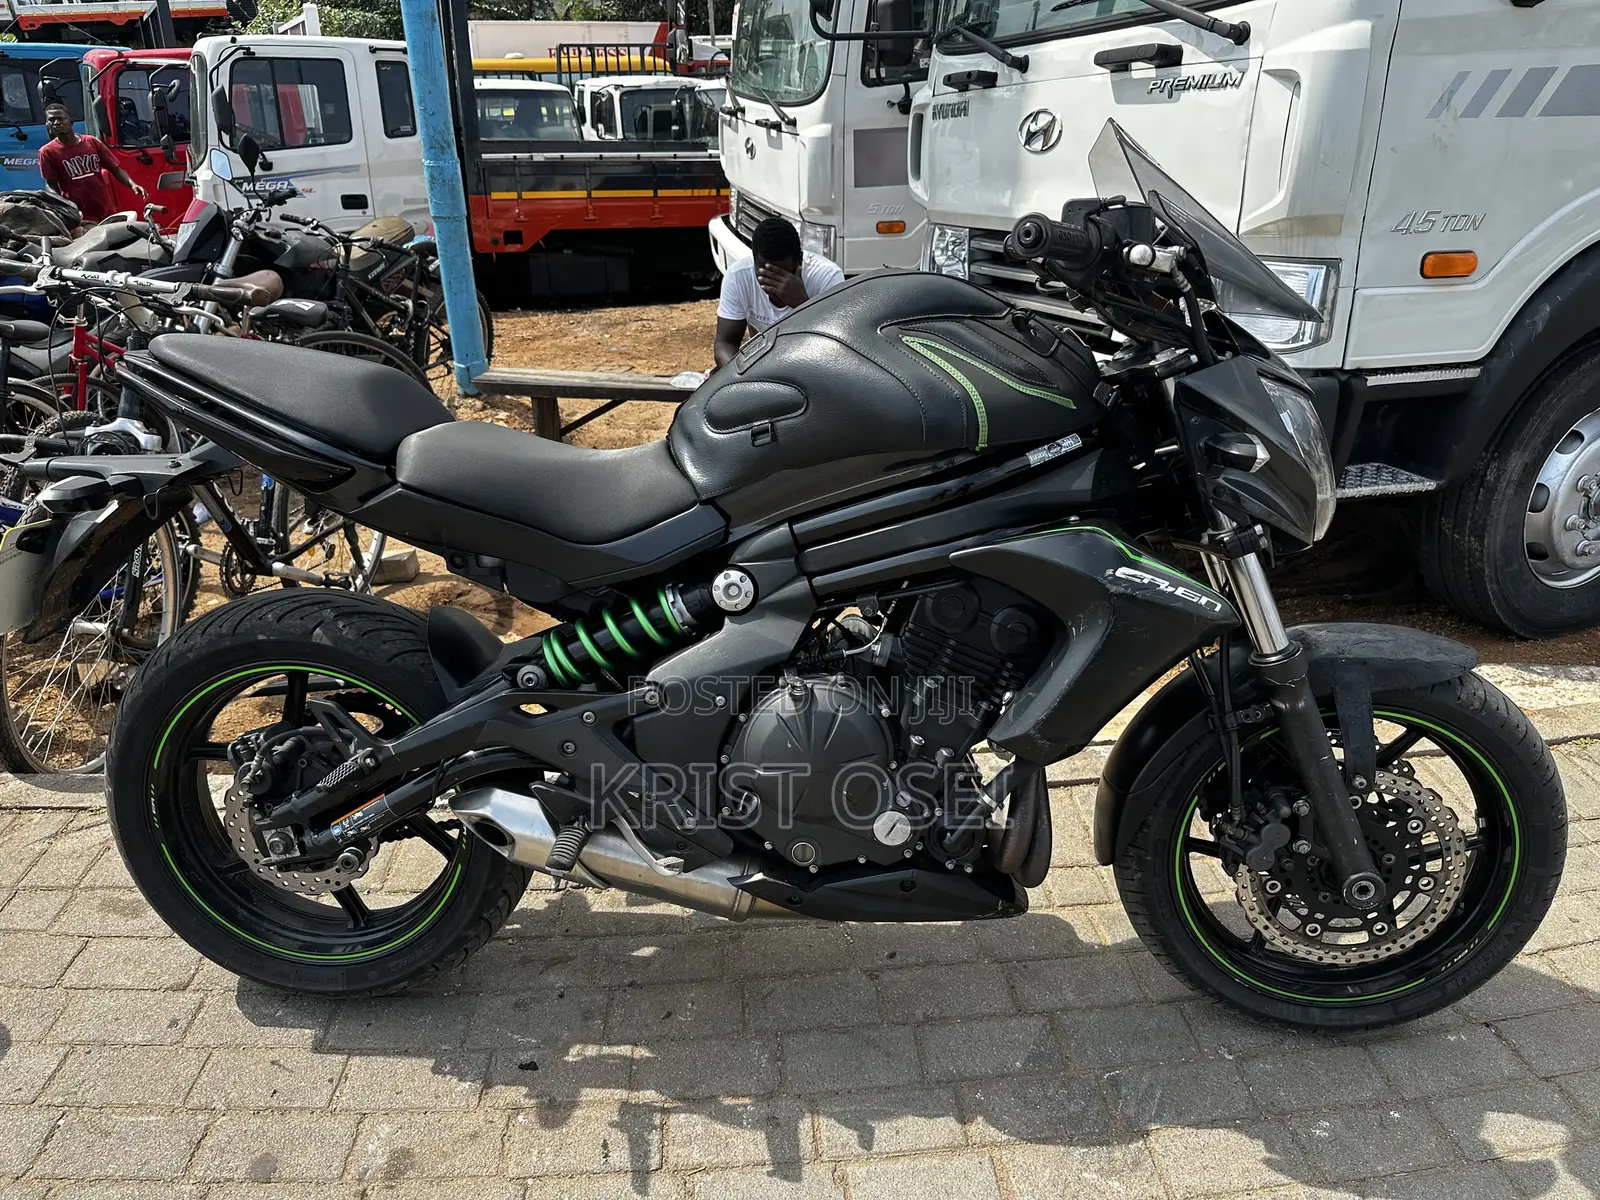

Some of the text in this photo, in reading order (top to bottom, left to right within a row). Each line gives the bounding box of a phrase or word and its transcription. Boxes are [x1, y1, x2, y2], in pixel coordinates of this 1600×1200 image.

[1146, 71, 1245, 99] PREMIUM
[62, 154, 100, 177] NYC
[242, 180, 289, 191] MEGA
[868, 203, 880, 215] 5
[1390, 209, 1487, 235] 4.5 TON
